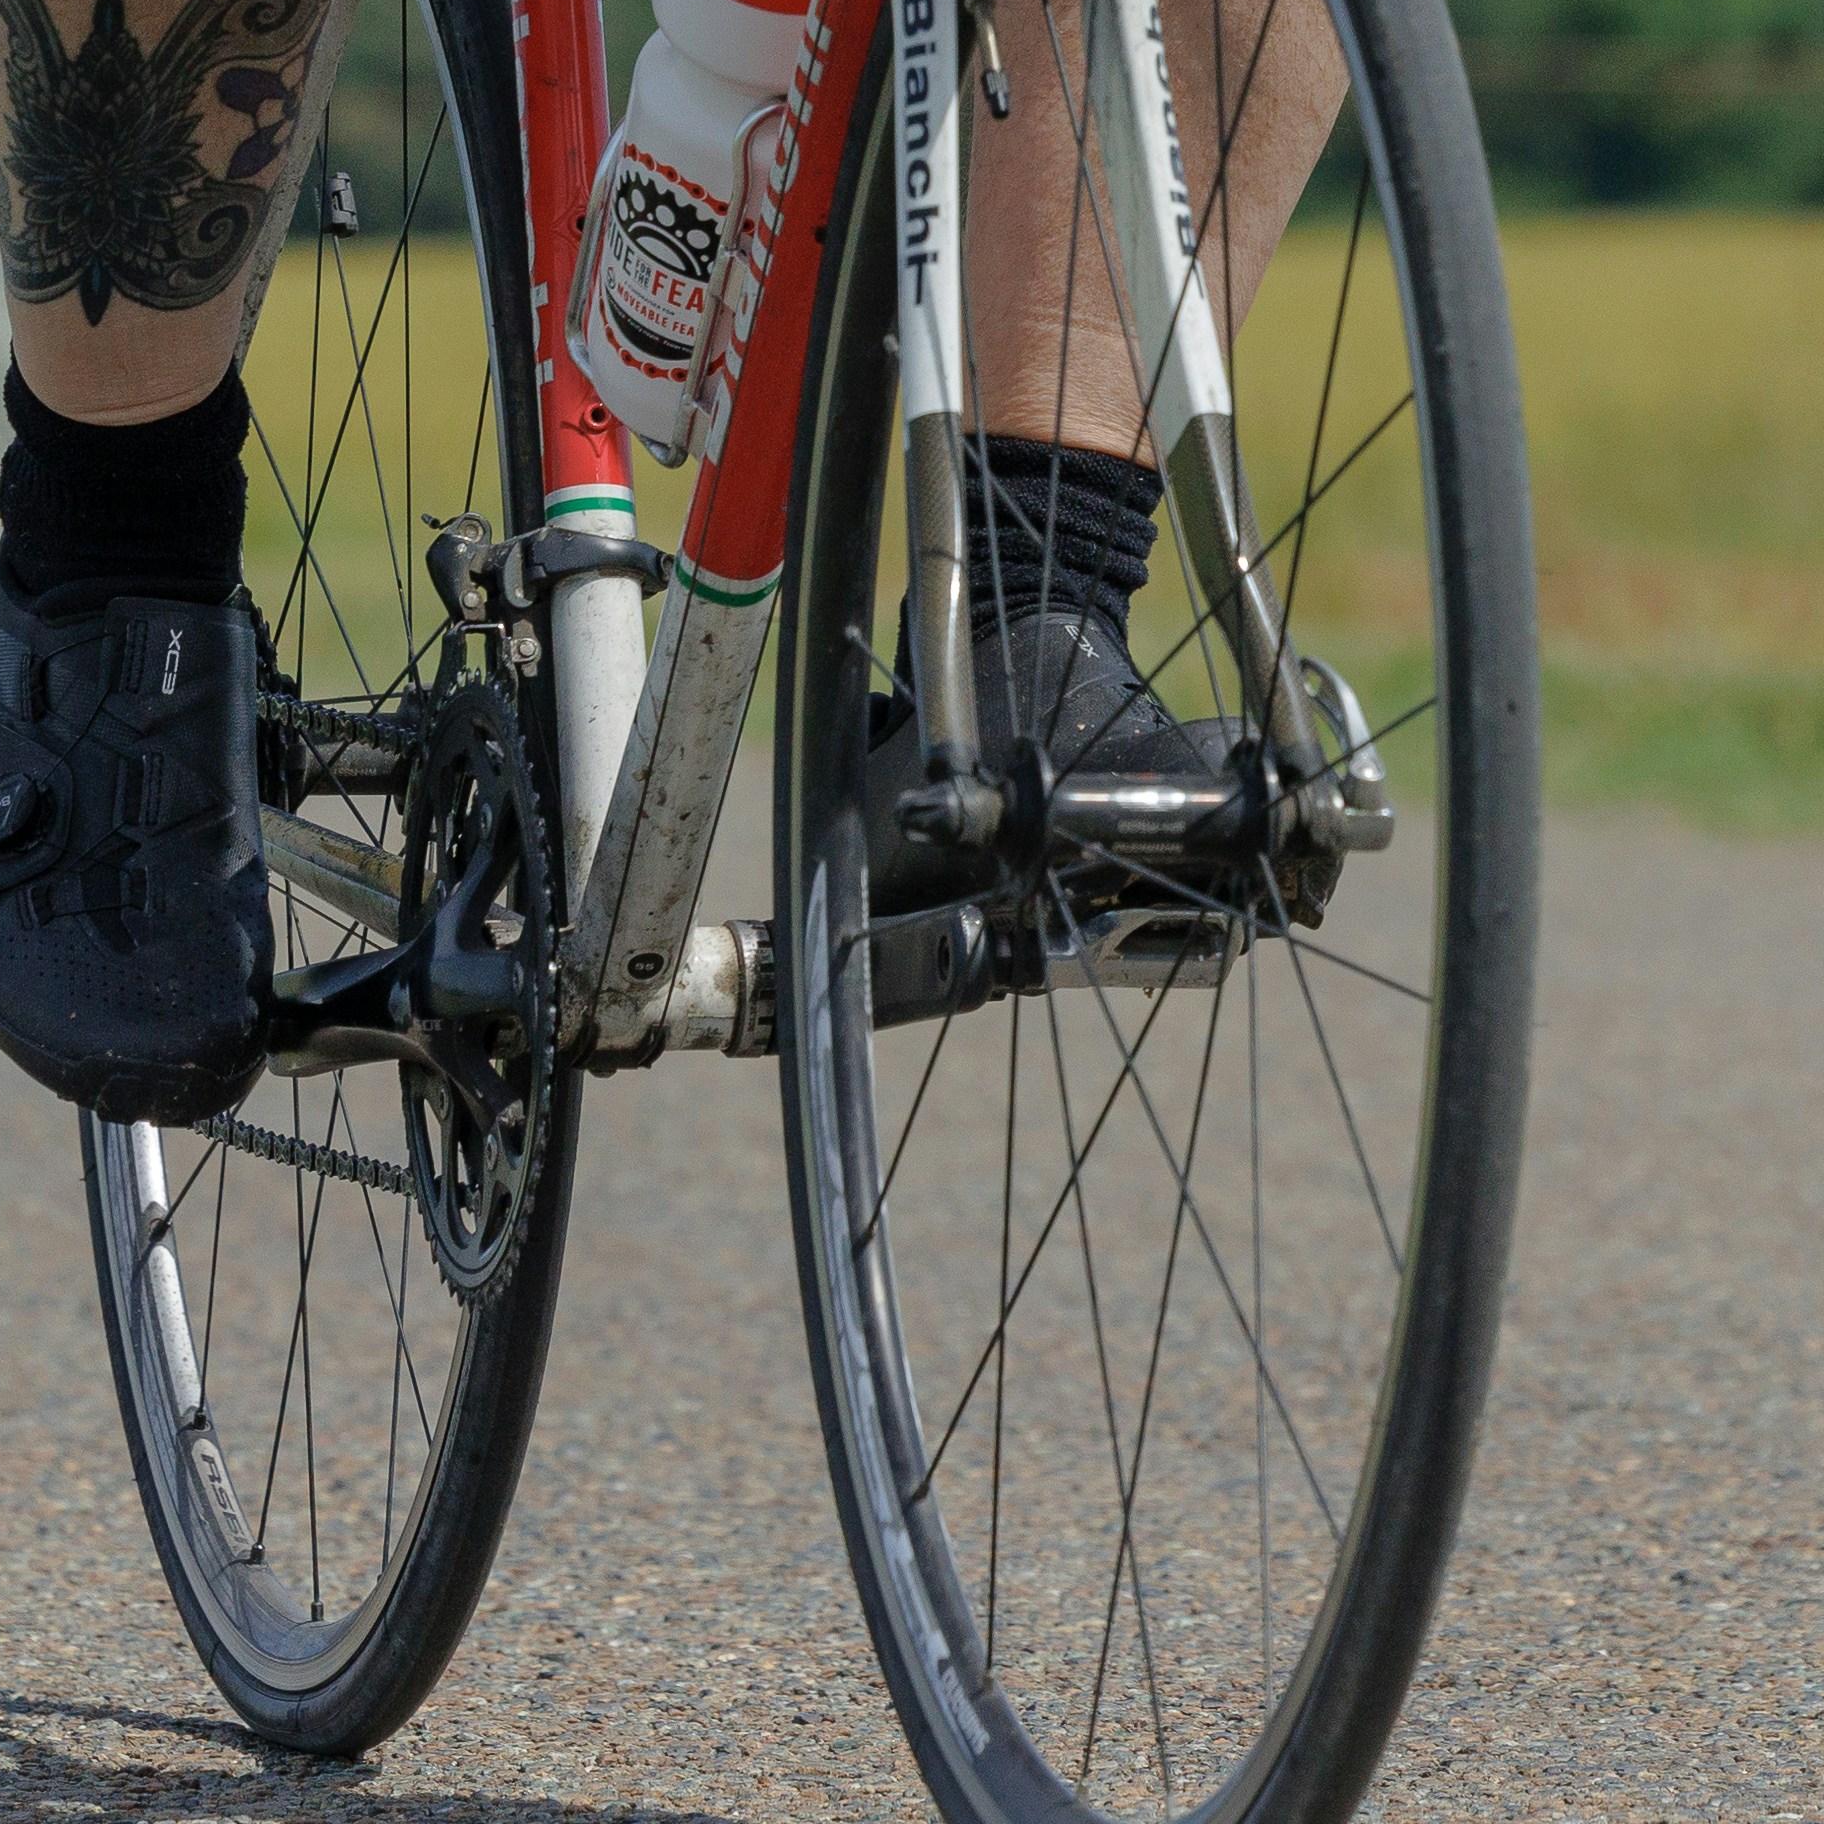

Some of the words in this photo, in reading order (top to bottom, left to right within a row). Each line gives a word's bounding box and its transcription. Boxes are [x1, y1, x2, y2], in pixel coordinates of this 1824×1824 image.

[634, 269, 650, 289] THE
[635, 258, 651, 277] FOR
[617, 282, 669, 328] MOVEABLE
[671, 321, 695, 337] FEA
[651, 269, 705, 314] FEA
[162, 628, 183, 695] XC3
